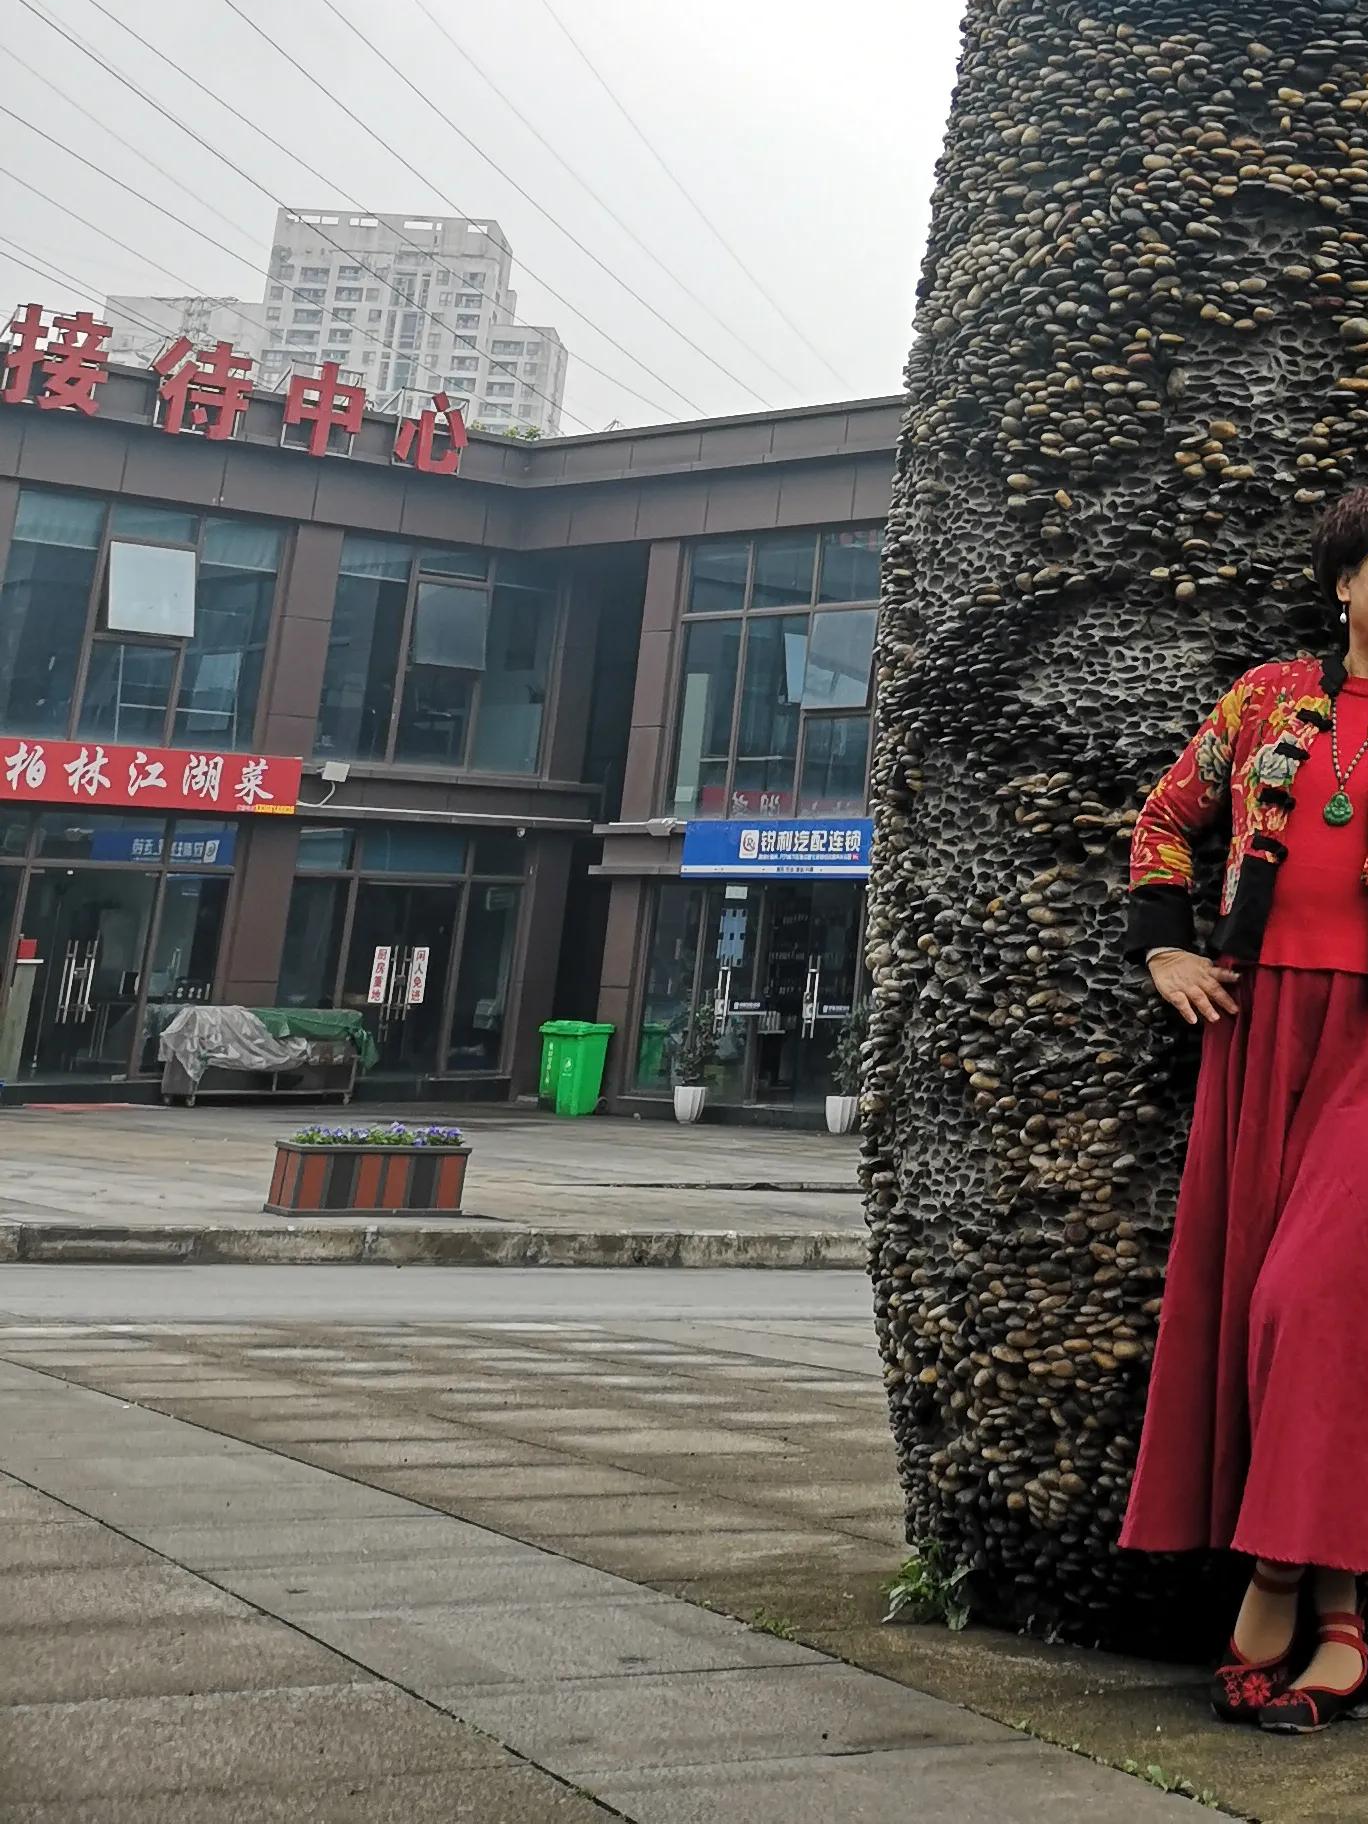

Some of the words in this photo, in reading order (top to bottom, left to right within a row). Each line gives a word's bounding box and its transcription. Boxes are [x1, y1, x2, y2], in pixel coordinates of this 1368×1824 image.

[3, 303, 468, 474] 接待中心
[4, 742, 275, 803] 柏林江湖菜
[371, 949, 388, 1002] 厨房重地
[411, 950, 427, 1002] 闲人免进
